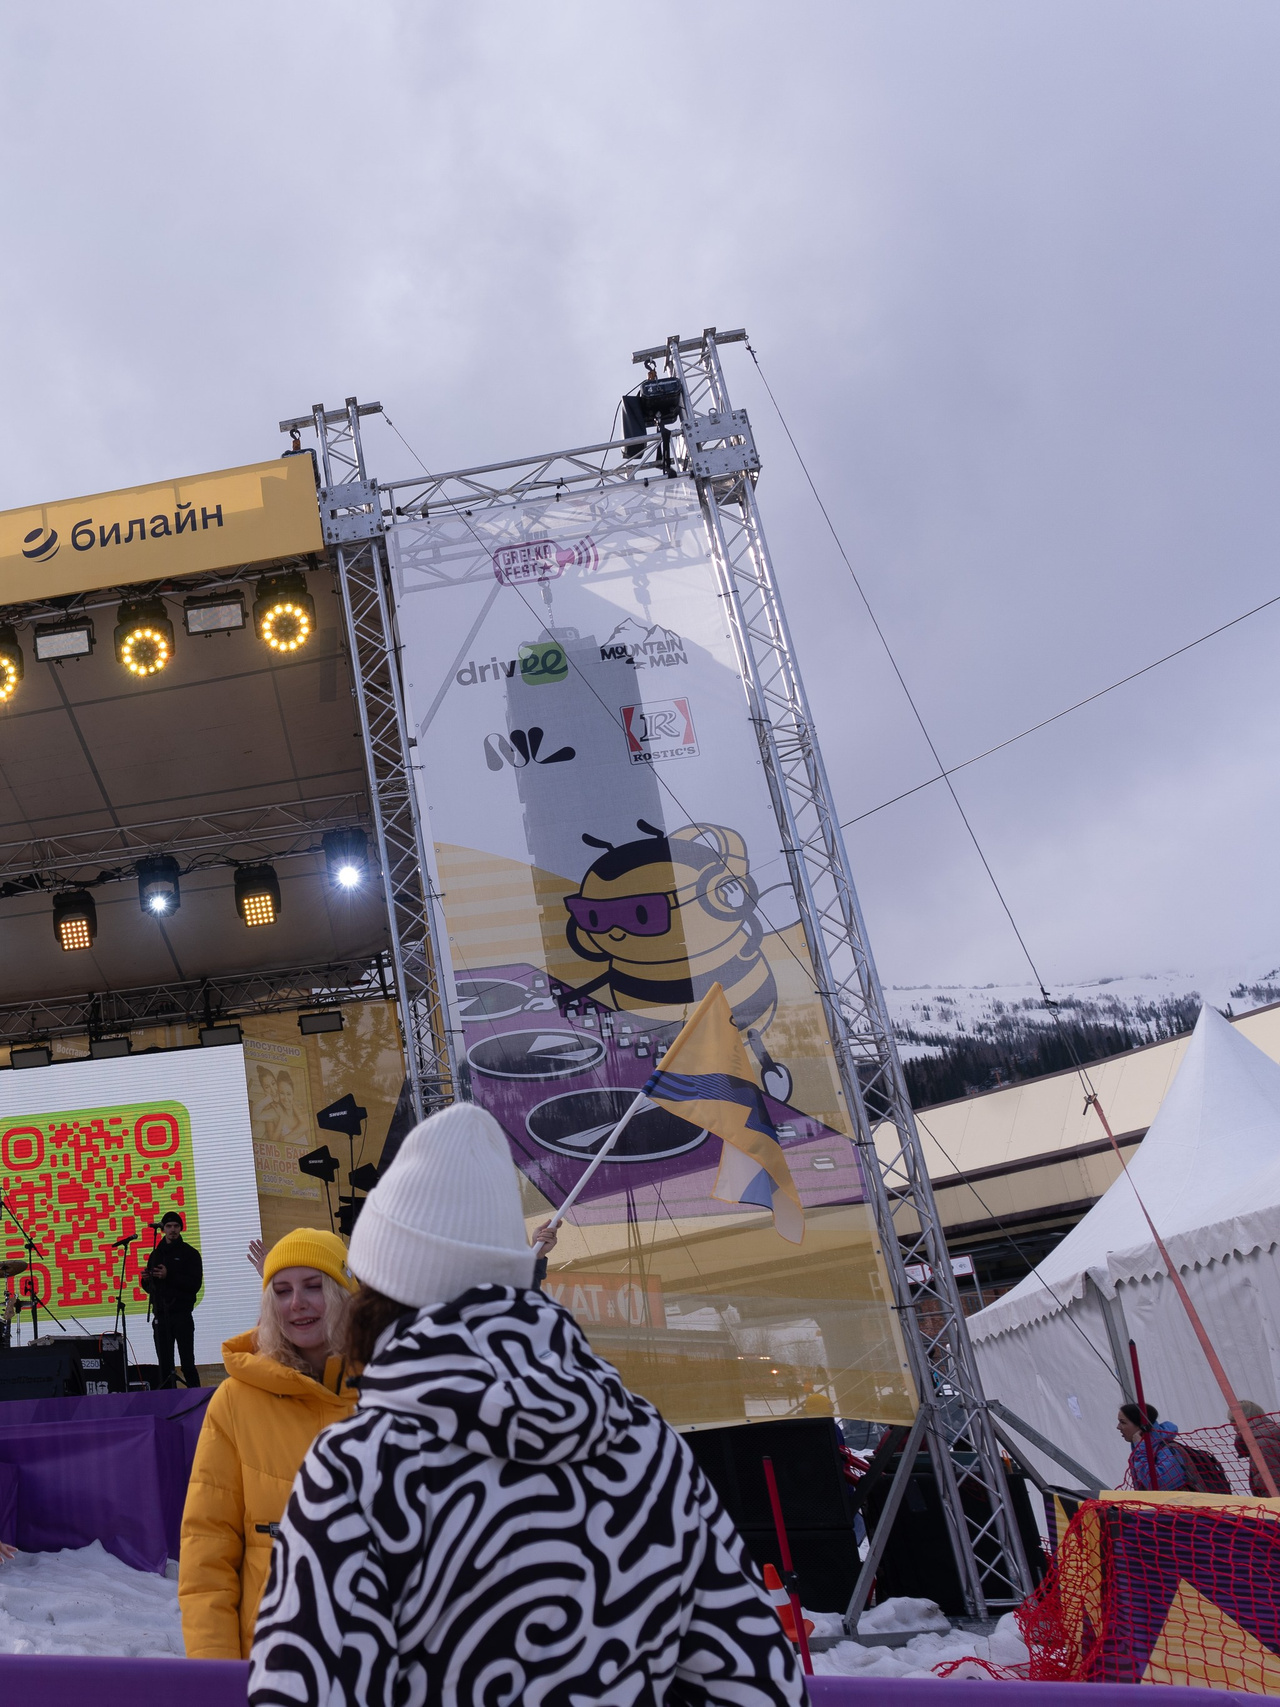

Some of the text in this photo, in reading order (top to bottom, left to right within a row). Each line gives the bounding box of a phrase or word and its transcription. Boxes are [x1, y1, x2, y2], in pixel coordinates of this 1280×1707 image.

[71, 501, 224, 552] билайн
[502, 545, 552, 566] GRELKA
[505, 563, 539, 579] FEST
[600, 639, 685, 661] MOUNTAIN
[456, 649, 568, 686] drivee
[649, 652, 689, 668] MAN
[633, 746, 696, 762] ROSTIC'S
[56, 1043, 90, 1057] Восстано
[243, 1039, 300, 1056] ГЛОСУТОЧНО
[286, 1146, 309, 1160] БАН
[257, 1157, 299, 1175] НА ГОРЕ
